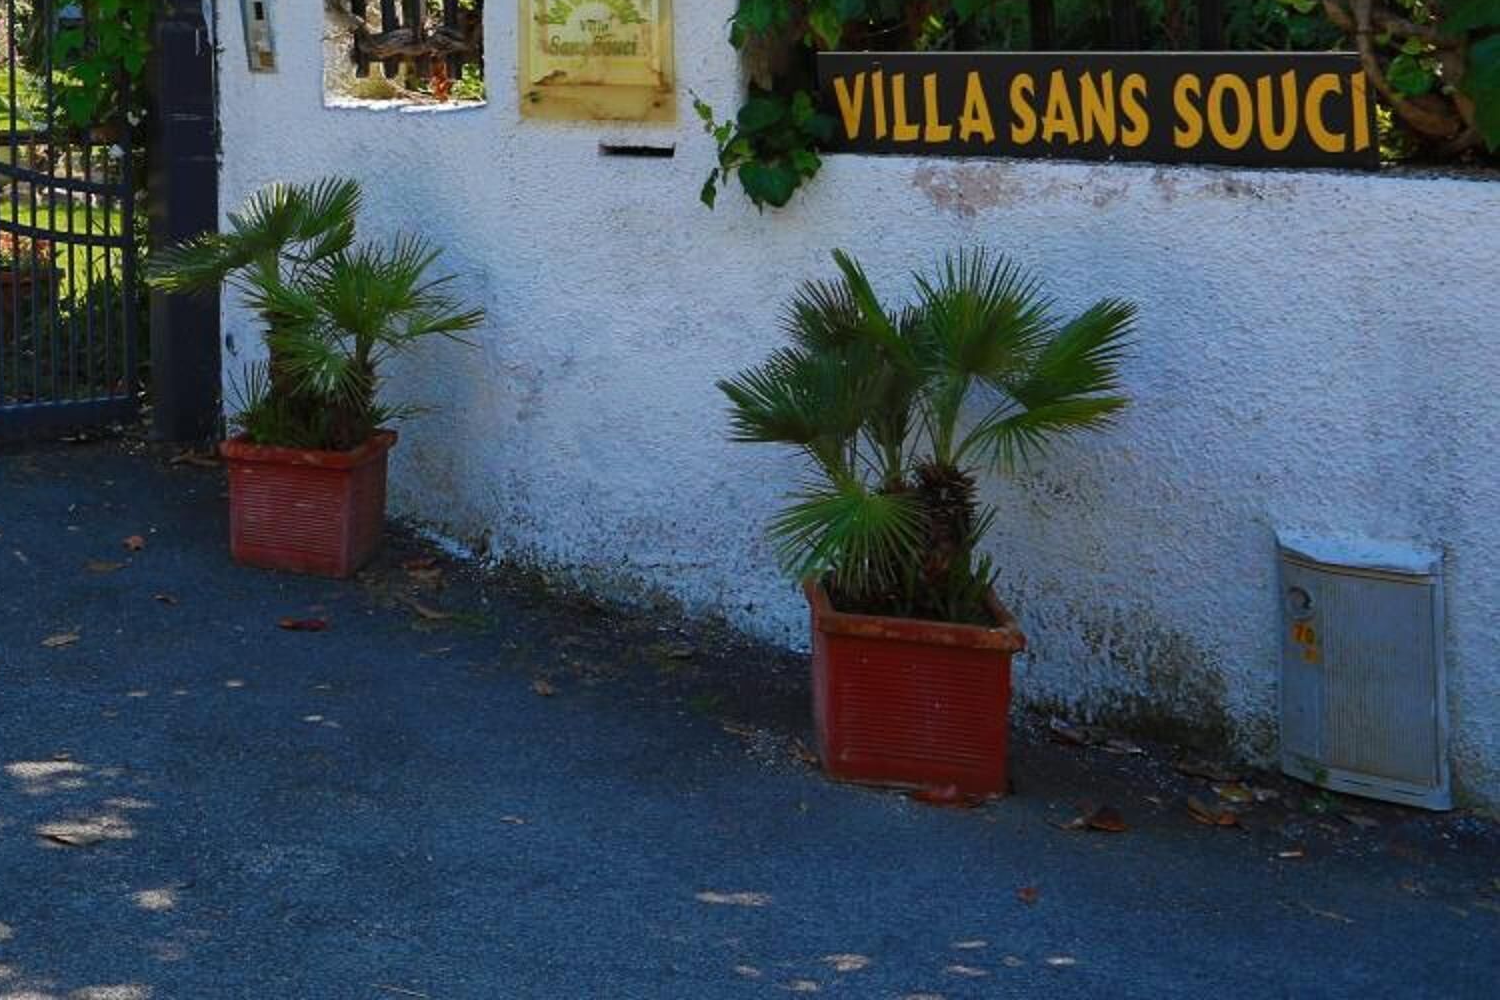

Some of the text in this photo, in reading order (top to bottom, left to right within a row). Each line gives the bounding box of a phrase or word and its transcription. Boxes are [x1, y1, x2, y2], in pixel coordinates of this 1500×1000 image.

[833, 67, 1370, 154] VILLA SANS SOUCI
